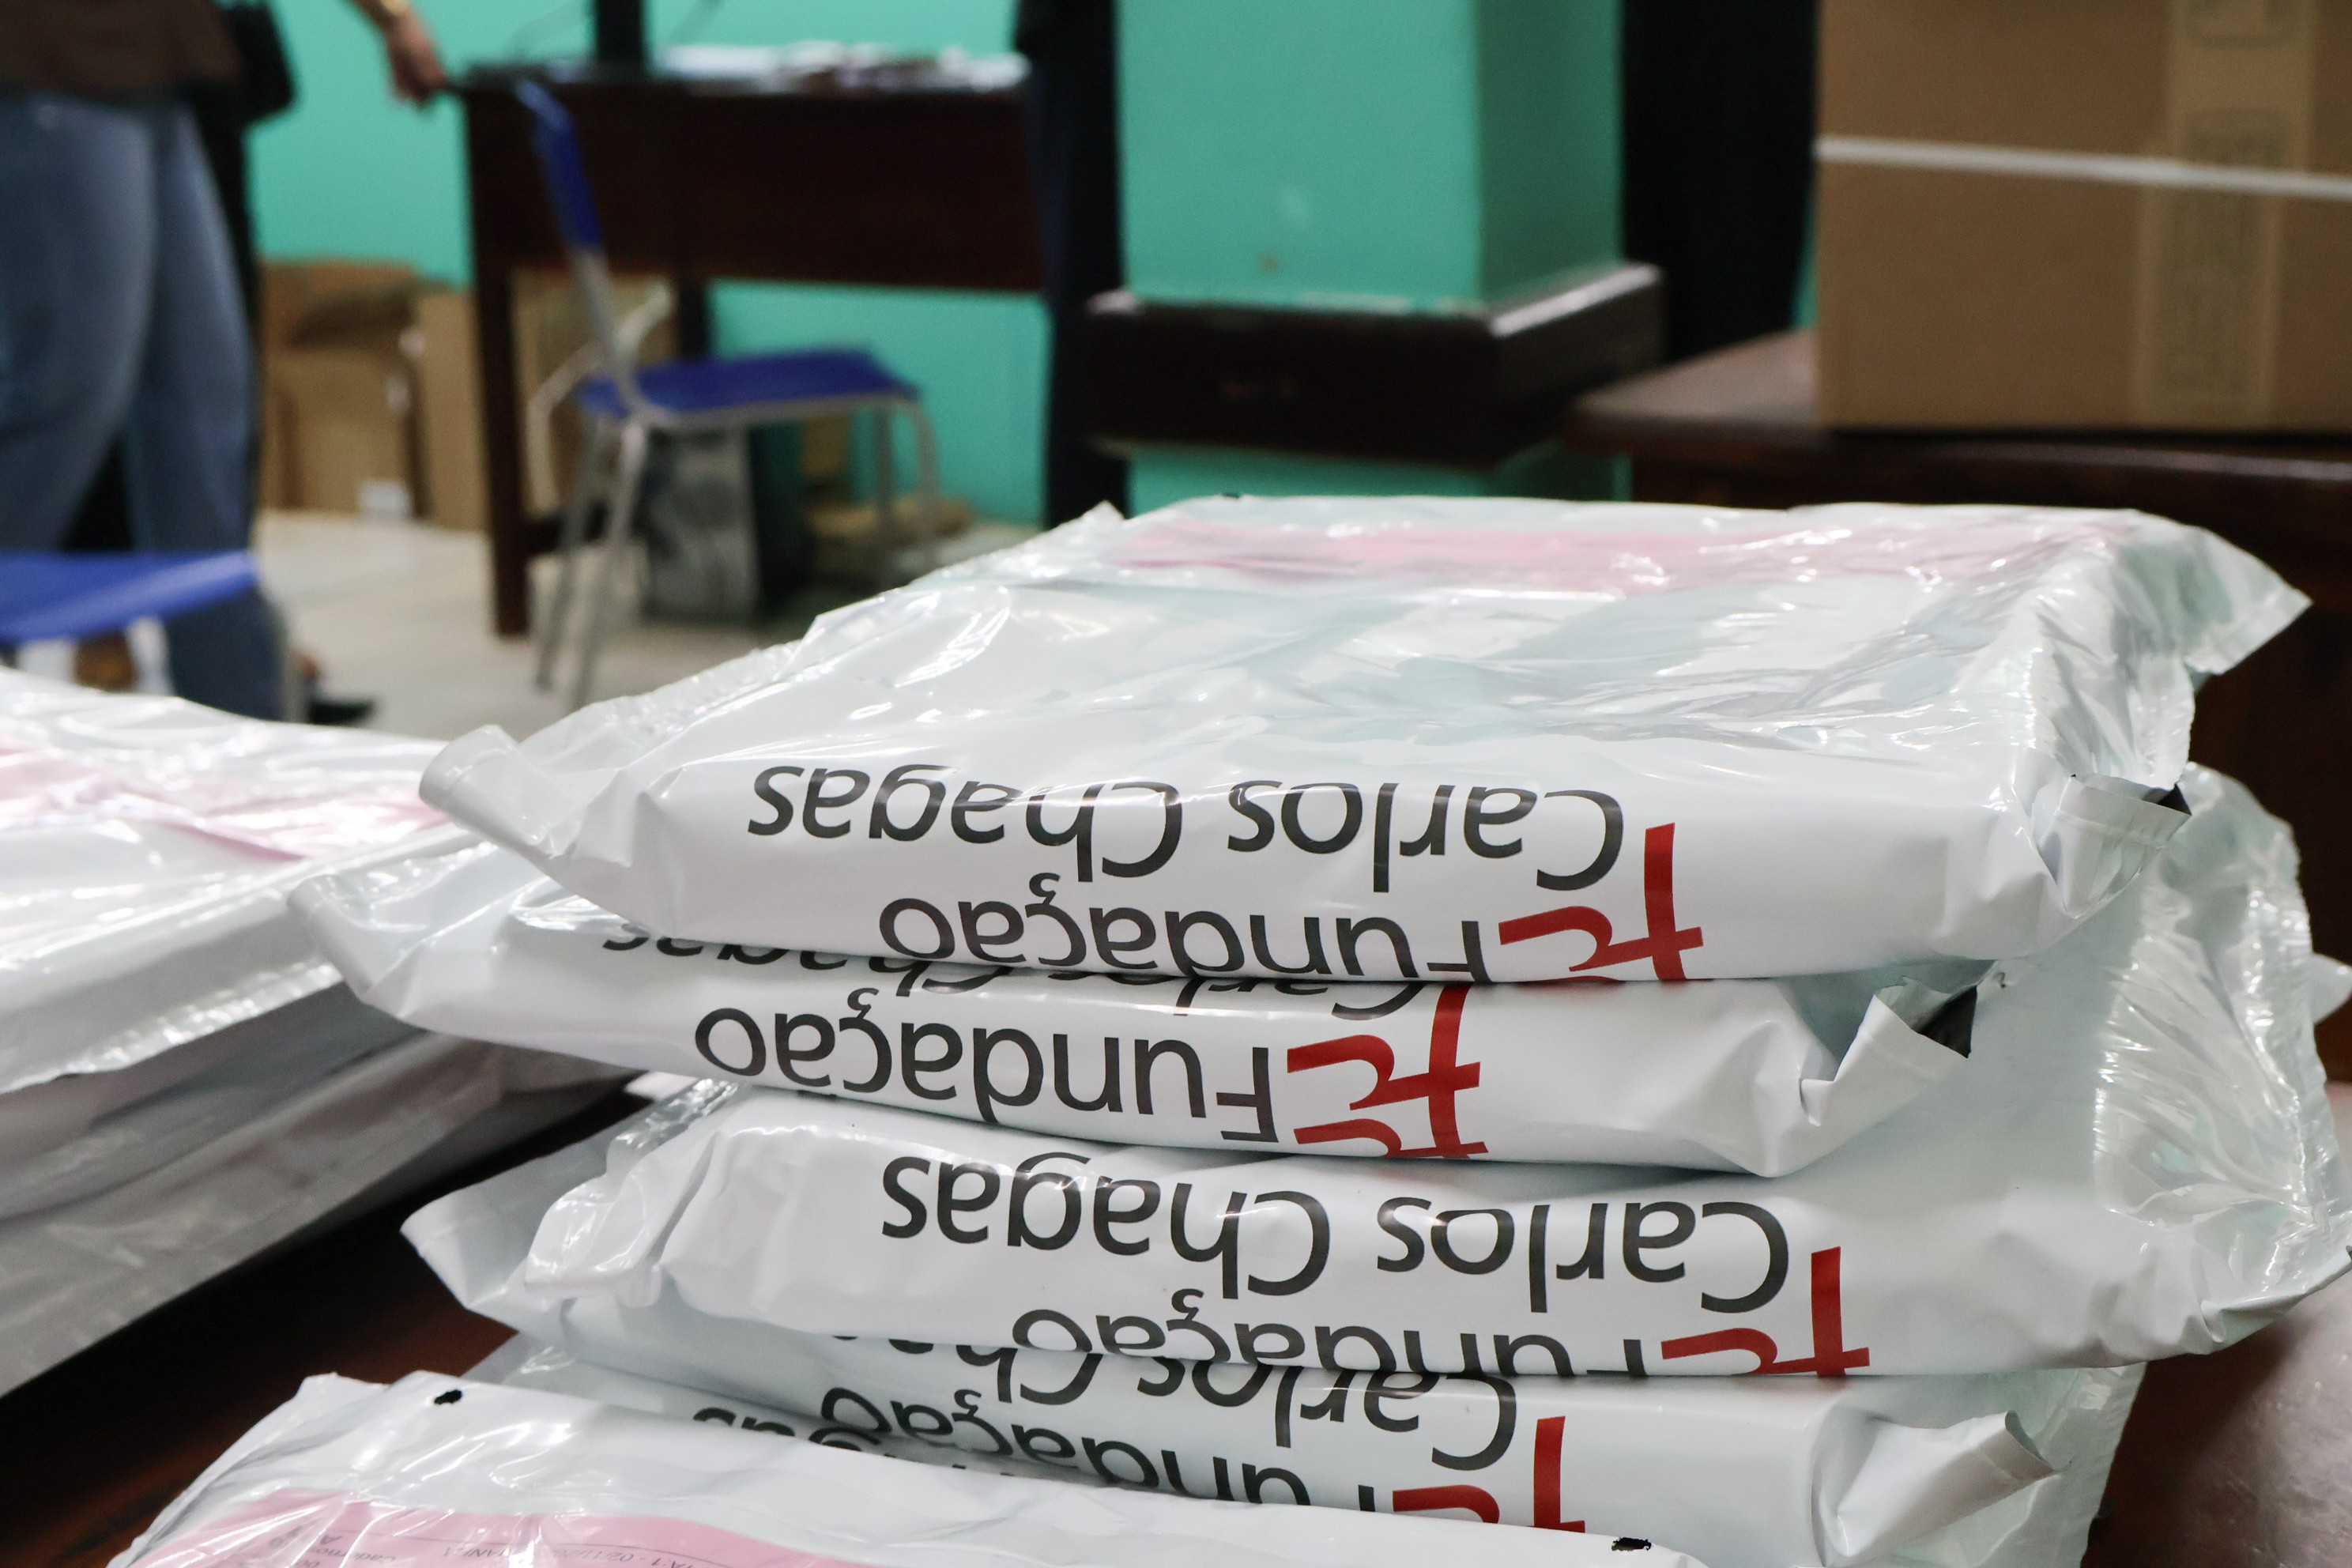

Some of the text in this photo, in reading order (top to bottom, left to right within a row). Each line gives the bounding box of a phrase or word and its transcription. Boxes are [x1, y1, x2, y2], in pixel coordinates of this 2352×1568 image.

[748, 765, 1624, 892] Carlos Chagas
[882, 1152, 1330, 1300] Chagas
[1377, 1197, 1789, 1314] Carlos
